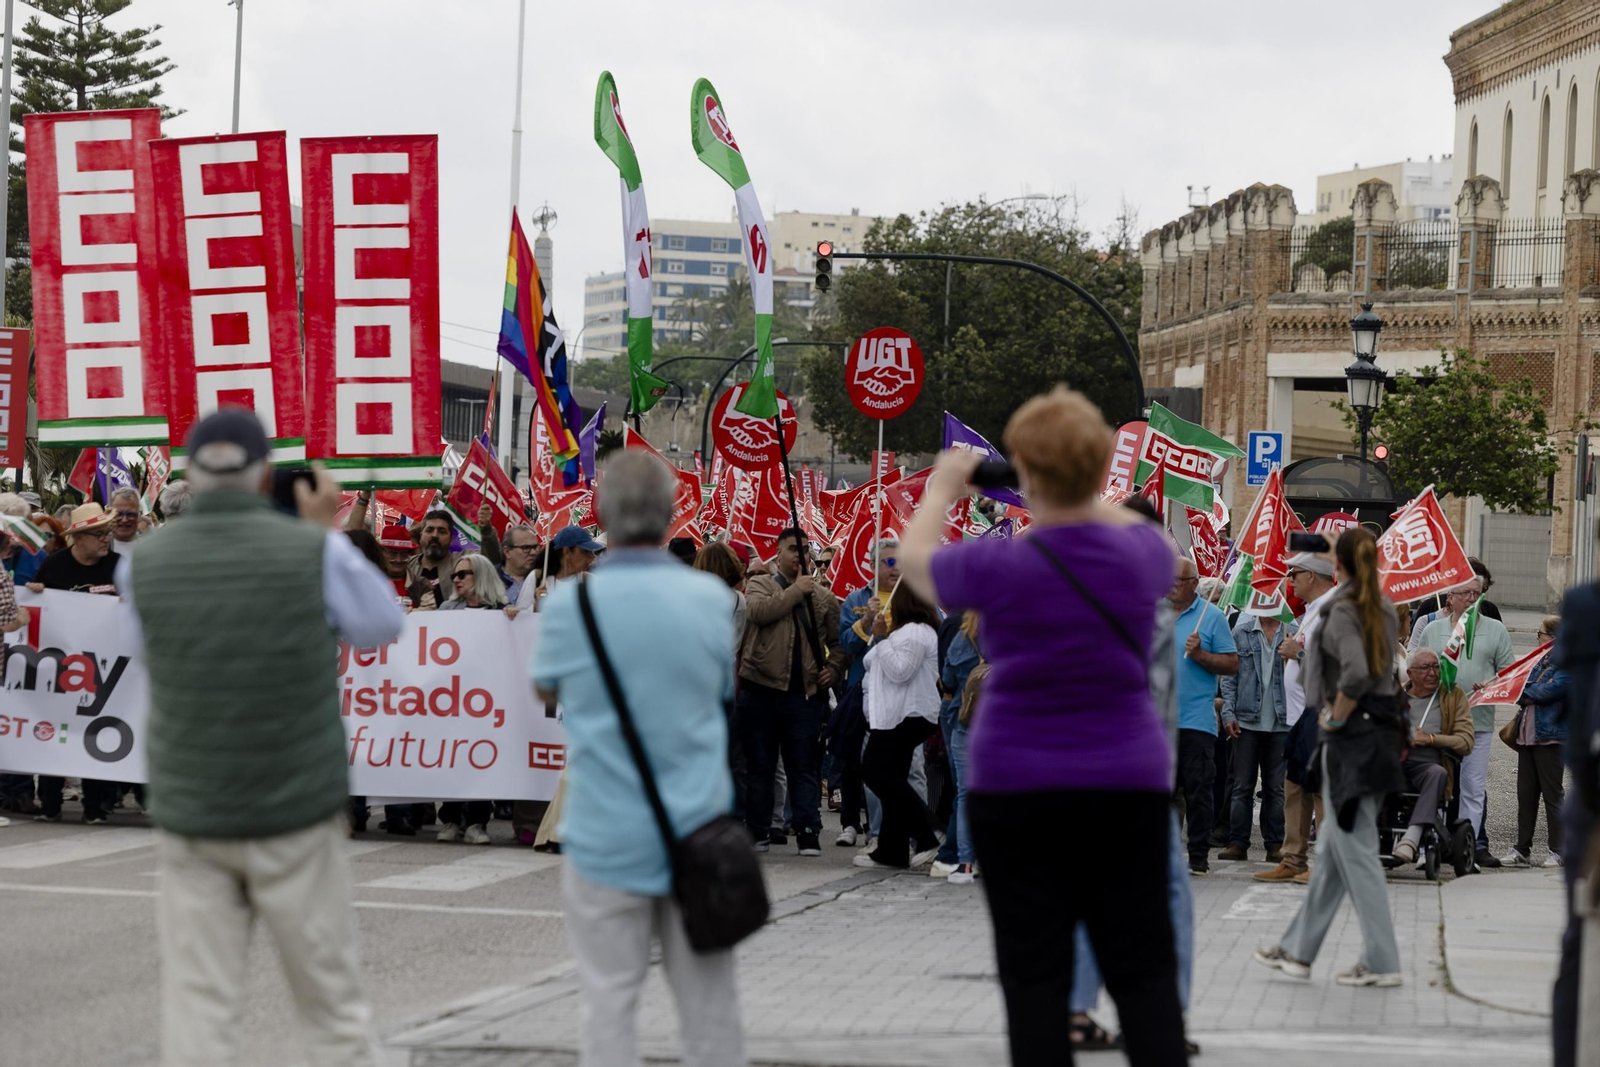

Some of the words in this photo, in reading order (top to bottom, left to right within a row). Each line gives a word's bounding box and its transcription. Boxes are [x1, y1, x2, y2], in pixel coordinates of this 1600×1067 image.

[54, 118, 145, 418] CCOO
[179, 140, 277, 438] CCOO
[331, 152, 413, 454] CCOO
[857, 337, 912, 371] UGT
[862, 395, 904, 409] Andalucía
[725, 443, 769, 462] Andalucía
[1255, 435, 1277, 463] P
[1402, 511, 1439, 563] UGT
[1390, 567, 1458, 594] www.ugt.es
[418, 626, 461, 666] lo
[338, 675, 506, 728] istado,
[349, 726, 498, 770] futuro
